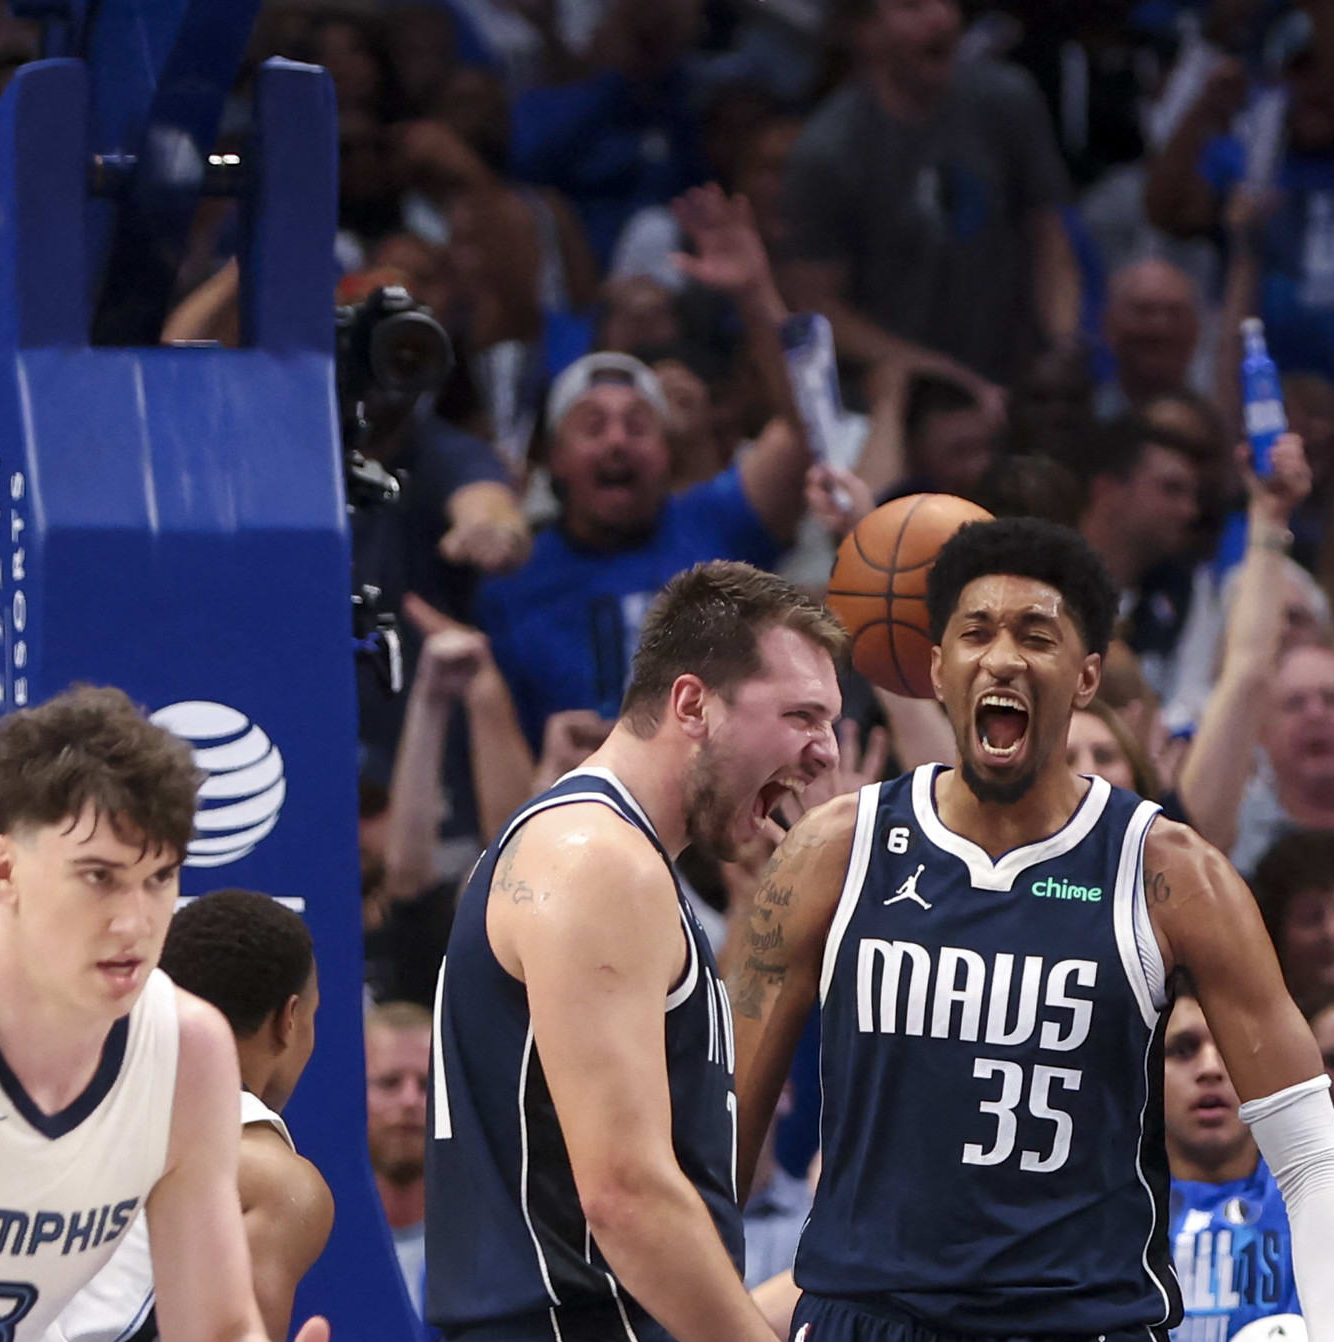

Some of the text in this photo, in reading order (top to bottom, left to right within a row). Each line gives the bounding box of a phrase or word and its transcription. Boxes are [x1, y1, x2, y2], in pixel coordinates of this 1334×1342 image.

[10, 472, 29, 707] ESORTS
[887, 826, 911, 855] 6
[1031, 877, 1103, 903] chime
[856, 937, 1099, 1052] MAVS
[961, 1057, 1083, 1174] 35
